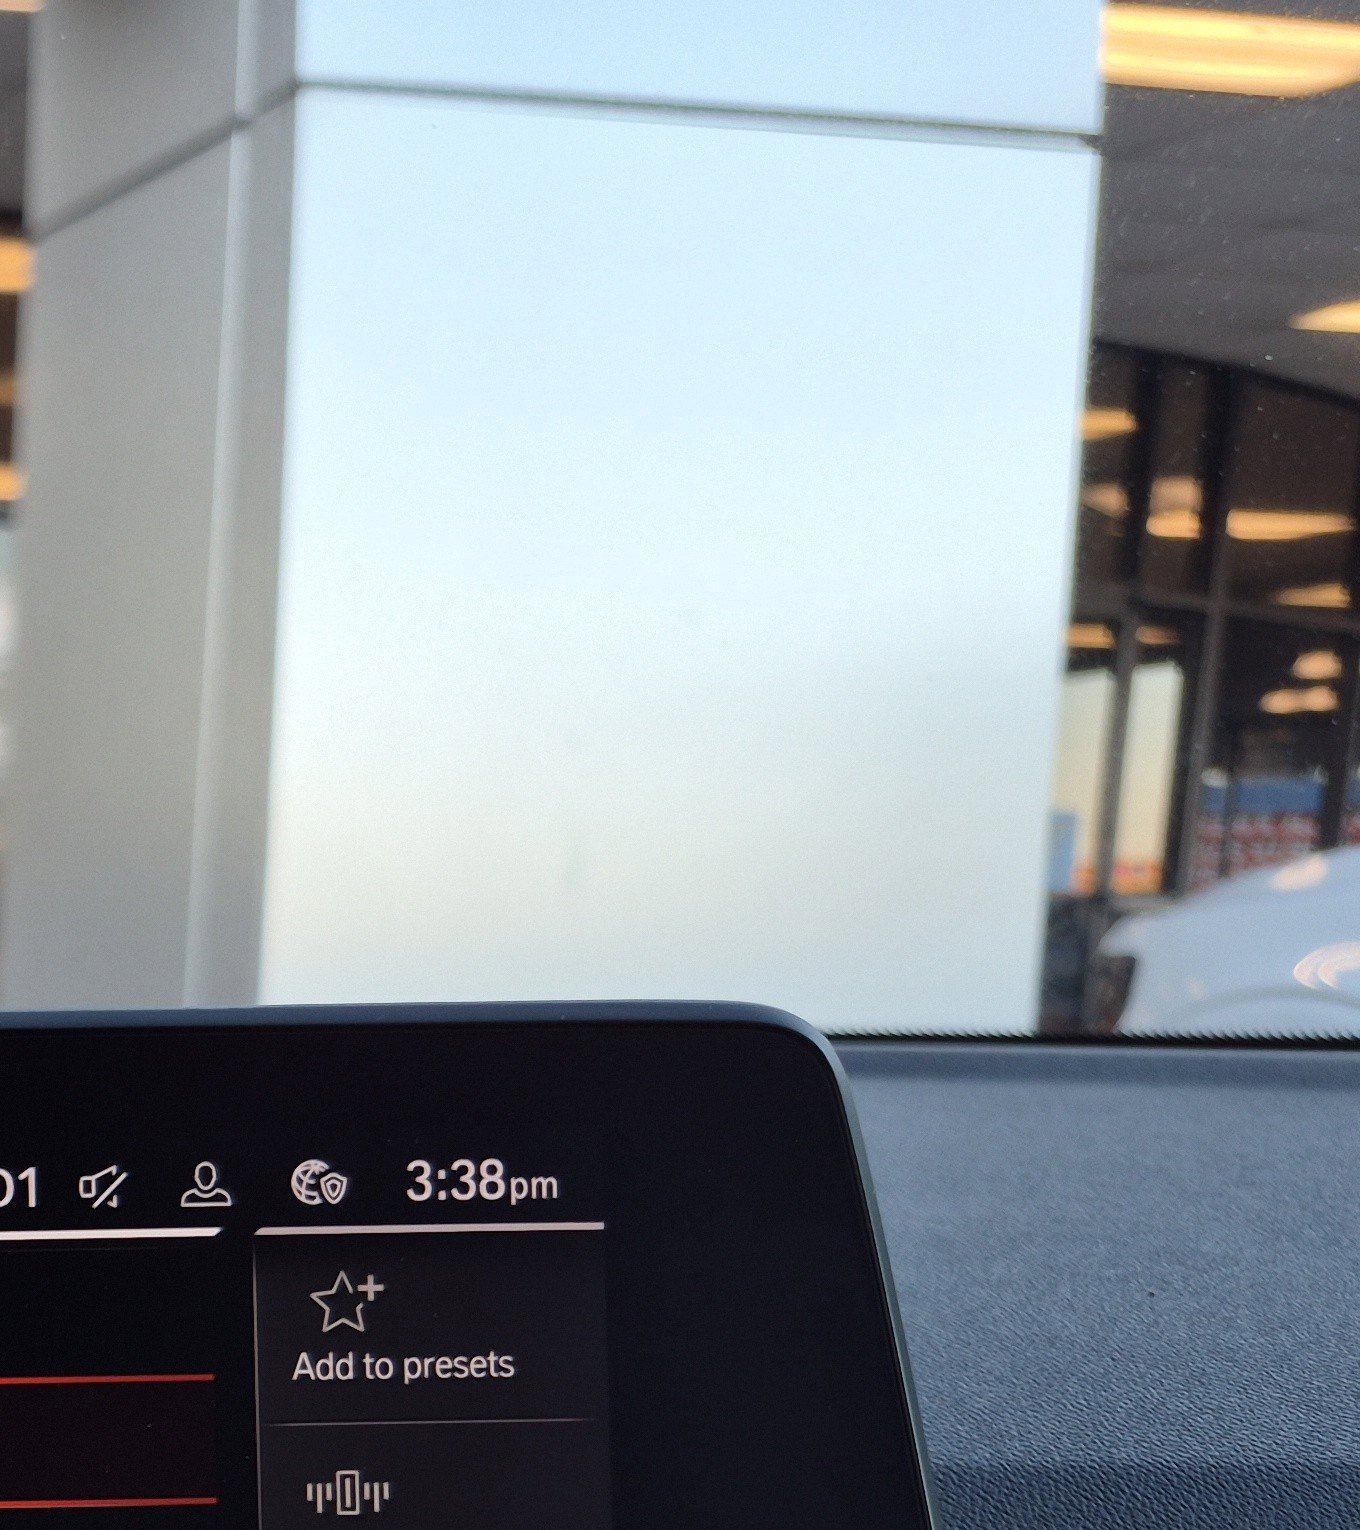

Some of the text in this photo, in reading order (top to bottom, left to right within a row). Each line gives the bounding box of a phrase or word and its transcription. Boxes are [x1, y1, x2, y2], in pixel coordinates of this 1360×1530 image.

[291, 1350, 515, 1385] Add to presets
